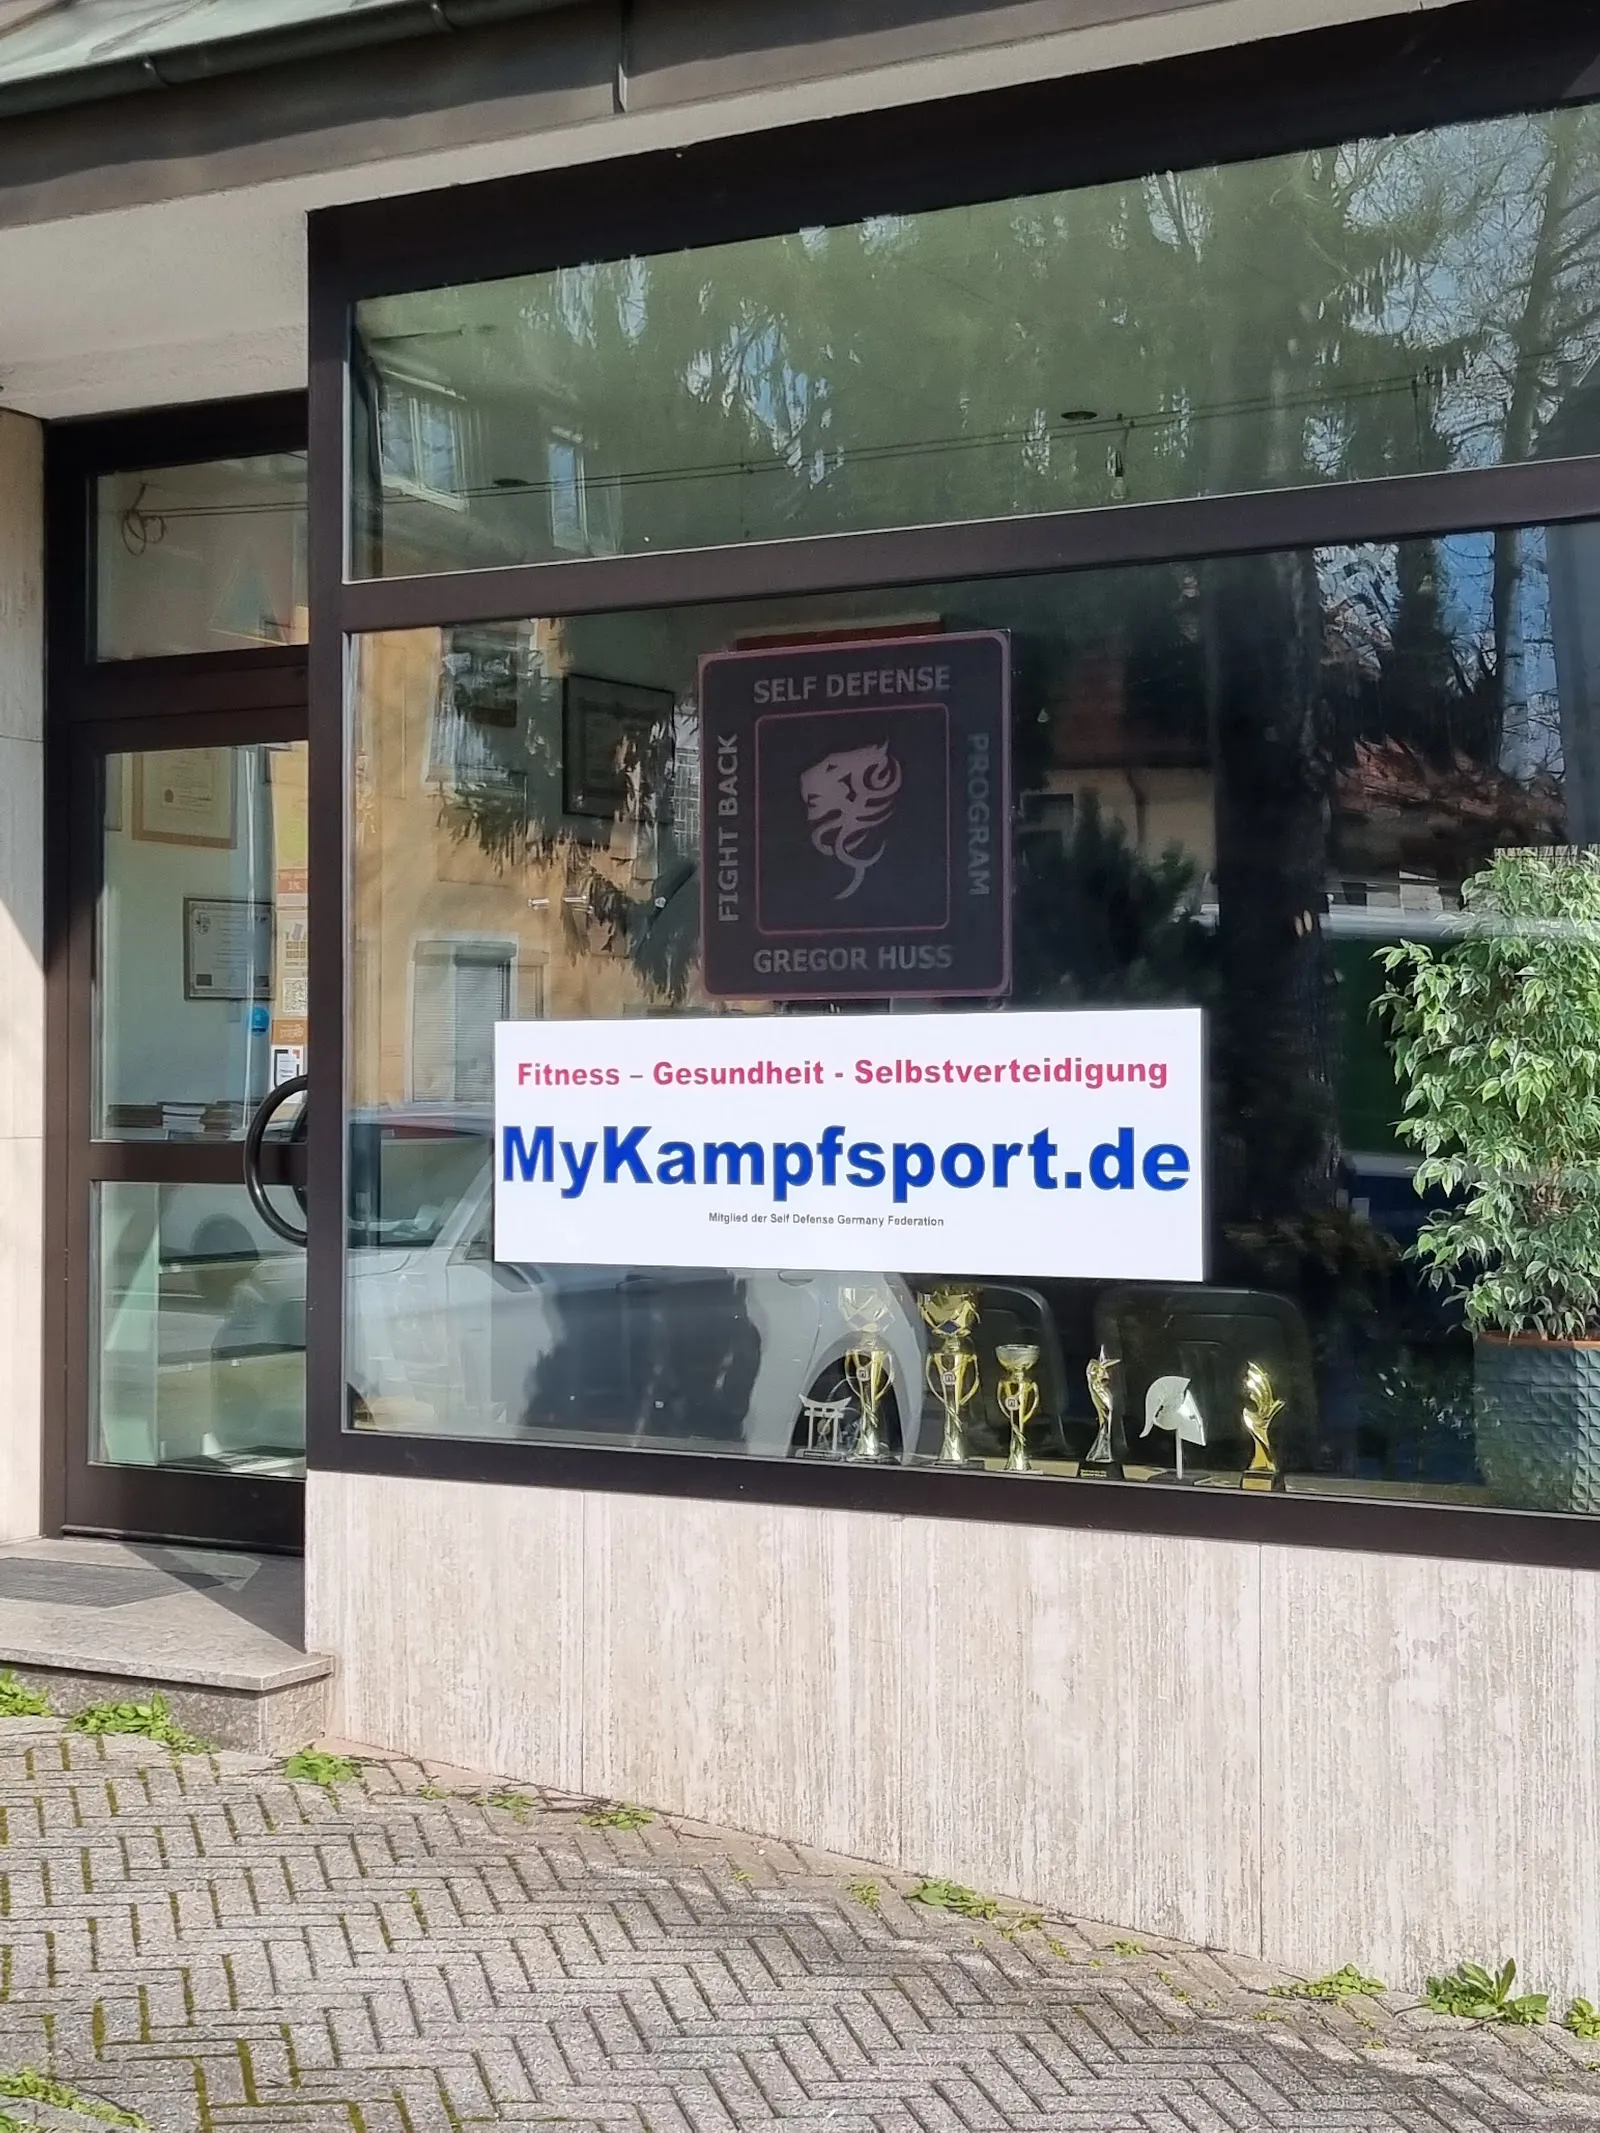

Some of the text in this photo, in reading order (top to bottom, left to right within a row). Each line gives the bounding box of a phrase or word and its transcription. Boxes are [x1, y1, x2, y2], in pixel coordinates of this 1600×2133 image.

[753, 665, 951, 704] SELF DEFENSE
[717, 733, 739, 923] FIGHT BACK
[967, 733, 991, 896] PROGRAM
[753, 945, 954, 974] GREGOR HUSS
[518, 1062, 620, 1086] Fitness
[652, 1060, 824, 1086] Gesundheit
[854, 1057, 1168, 1090] Selbstverteidigung
[502, 1124, 1191, 1204] MyKampfsport.de
[708, 1211, 945, 1228] Mitglied der Self Defense Germany Federation
